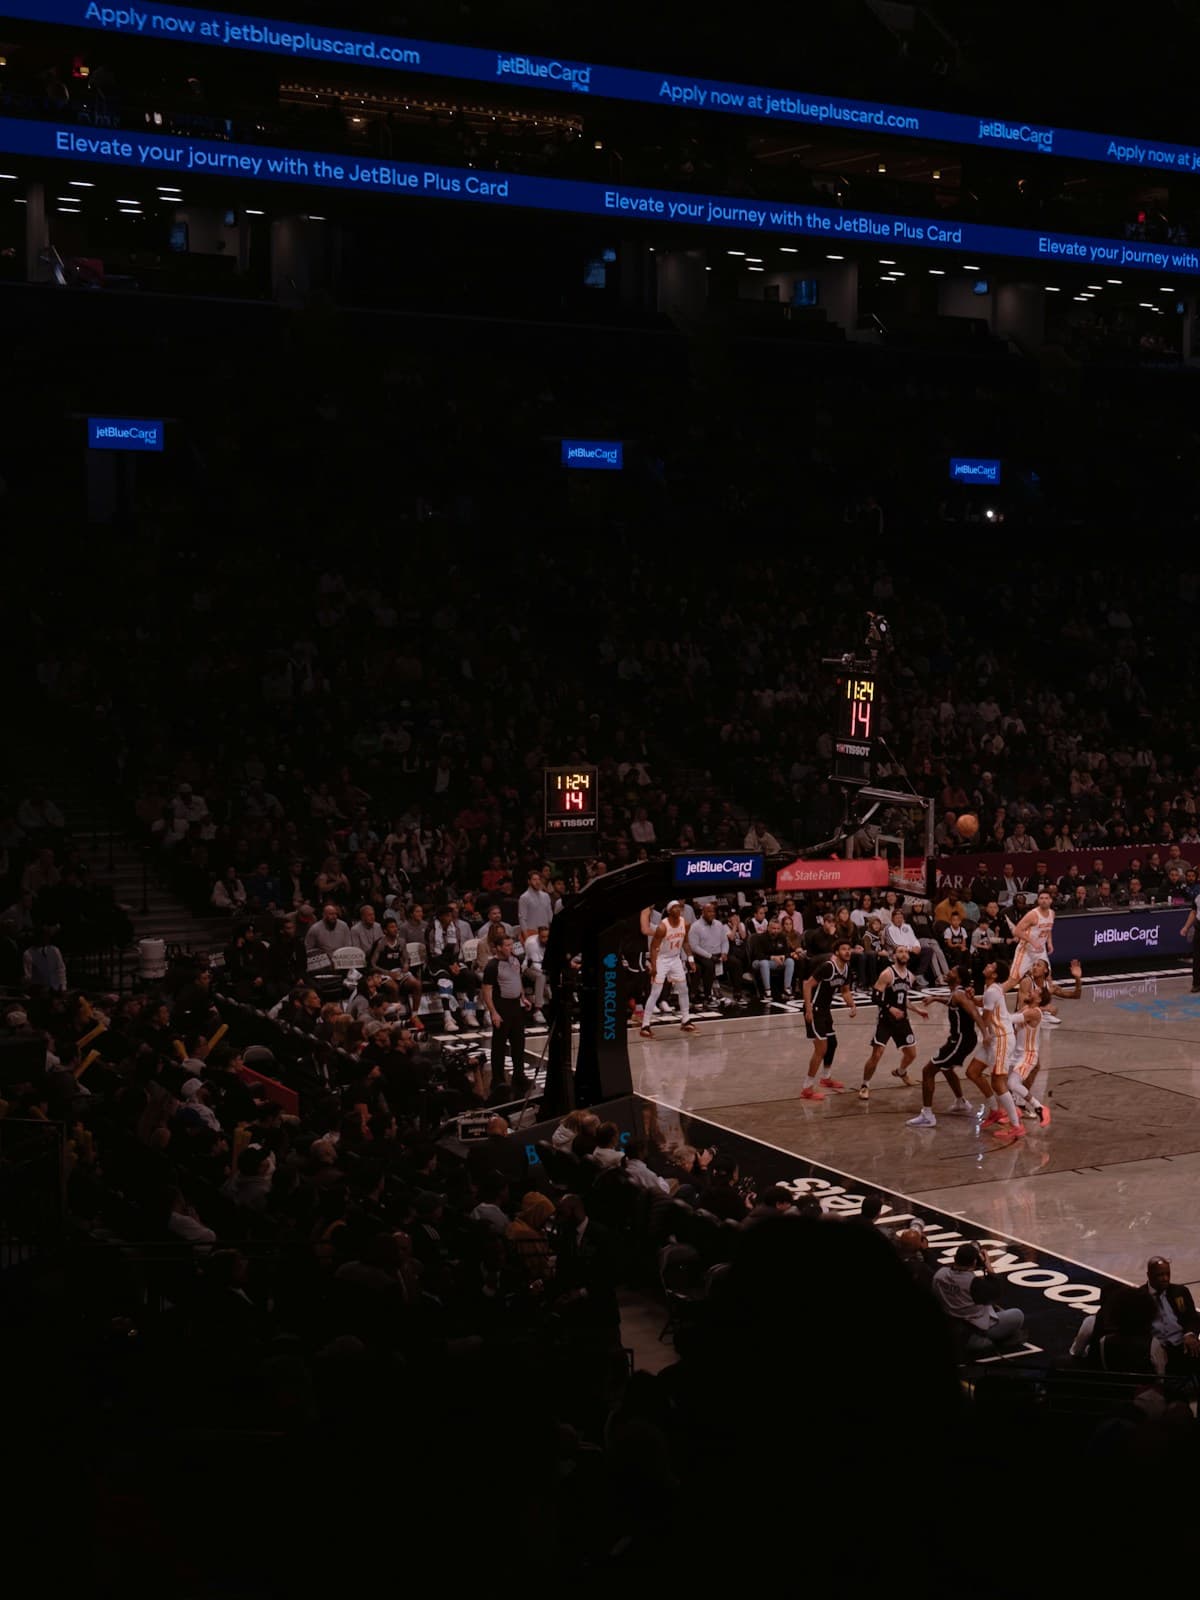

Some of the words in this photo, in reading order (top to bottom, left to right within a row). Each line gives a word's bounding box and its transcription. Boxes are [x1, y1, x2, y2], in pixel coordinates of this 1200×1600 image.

[85, 1, 147, 31] Apply
[152, 16, 196, 34] now
[199, 21, 220, 37] at
[223, 21, 420, 64] jetbluepluscard.com
[496, 55, 591, 76] jetBlueCard
[658, 80, 707, 107] Apply
[710, 90, 745, 108] now
[746, 93, 764, 110] at
[763, 92, 919, 131] jetbluepluscard.com
[978, 120, 1053, 145] jetBlueCard
[56, 131, 133, 157] Elevate
[137, 142, 184, 166] your
[187, 145, 263, 177] journey
[267, 154, 308, 178] with
[312, 159, 345, 182] the
[349, 164, 419, 188] JetBlue
[424, 170, 461, 192] Plus
[465, 176, 509, 197] Card
[1107, 141, 1147, 164] Apply
[1148, 150, 1175, 166] now
[1175, 152, 1191, 167] at
[604, 190, 665, 214] Elevate
[668, 201, 704, 222] your
[706, 200, 767, 227] journey
[770, 210, 803, 228] with
[806, 212, 831, 230] the
[834, 216, 890, 237] JetBlue
[894, 221, 924, 240] Plus
[926, 225, 962, 244] Card
[1038, 236, 1088, 258] Elevate
[1089, 244, 1119, 264] your
[1121, 247, 1169, 269] journey
[1171, 252, 1199, 269] with
[847, 679, 874, 702] 11:24
[851, 700, 872, 739] 14
[557, 773, 590, 790] 11:24
[565, 791, 583, 810] 14
[560, 818, 596, 829] TISSOT
[686, 859, 755, 876] jetBlueCard
[794, 870, 819, 881] State
[819, 870, 841, 881] Farm
[1093, 925, 1160, 947] jetBlueCard
[603, 971, 617, 1041] BARCLAYS
